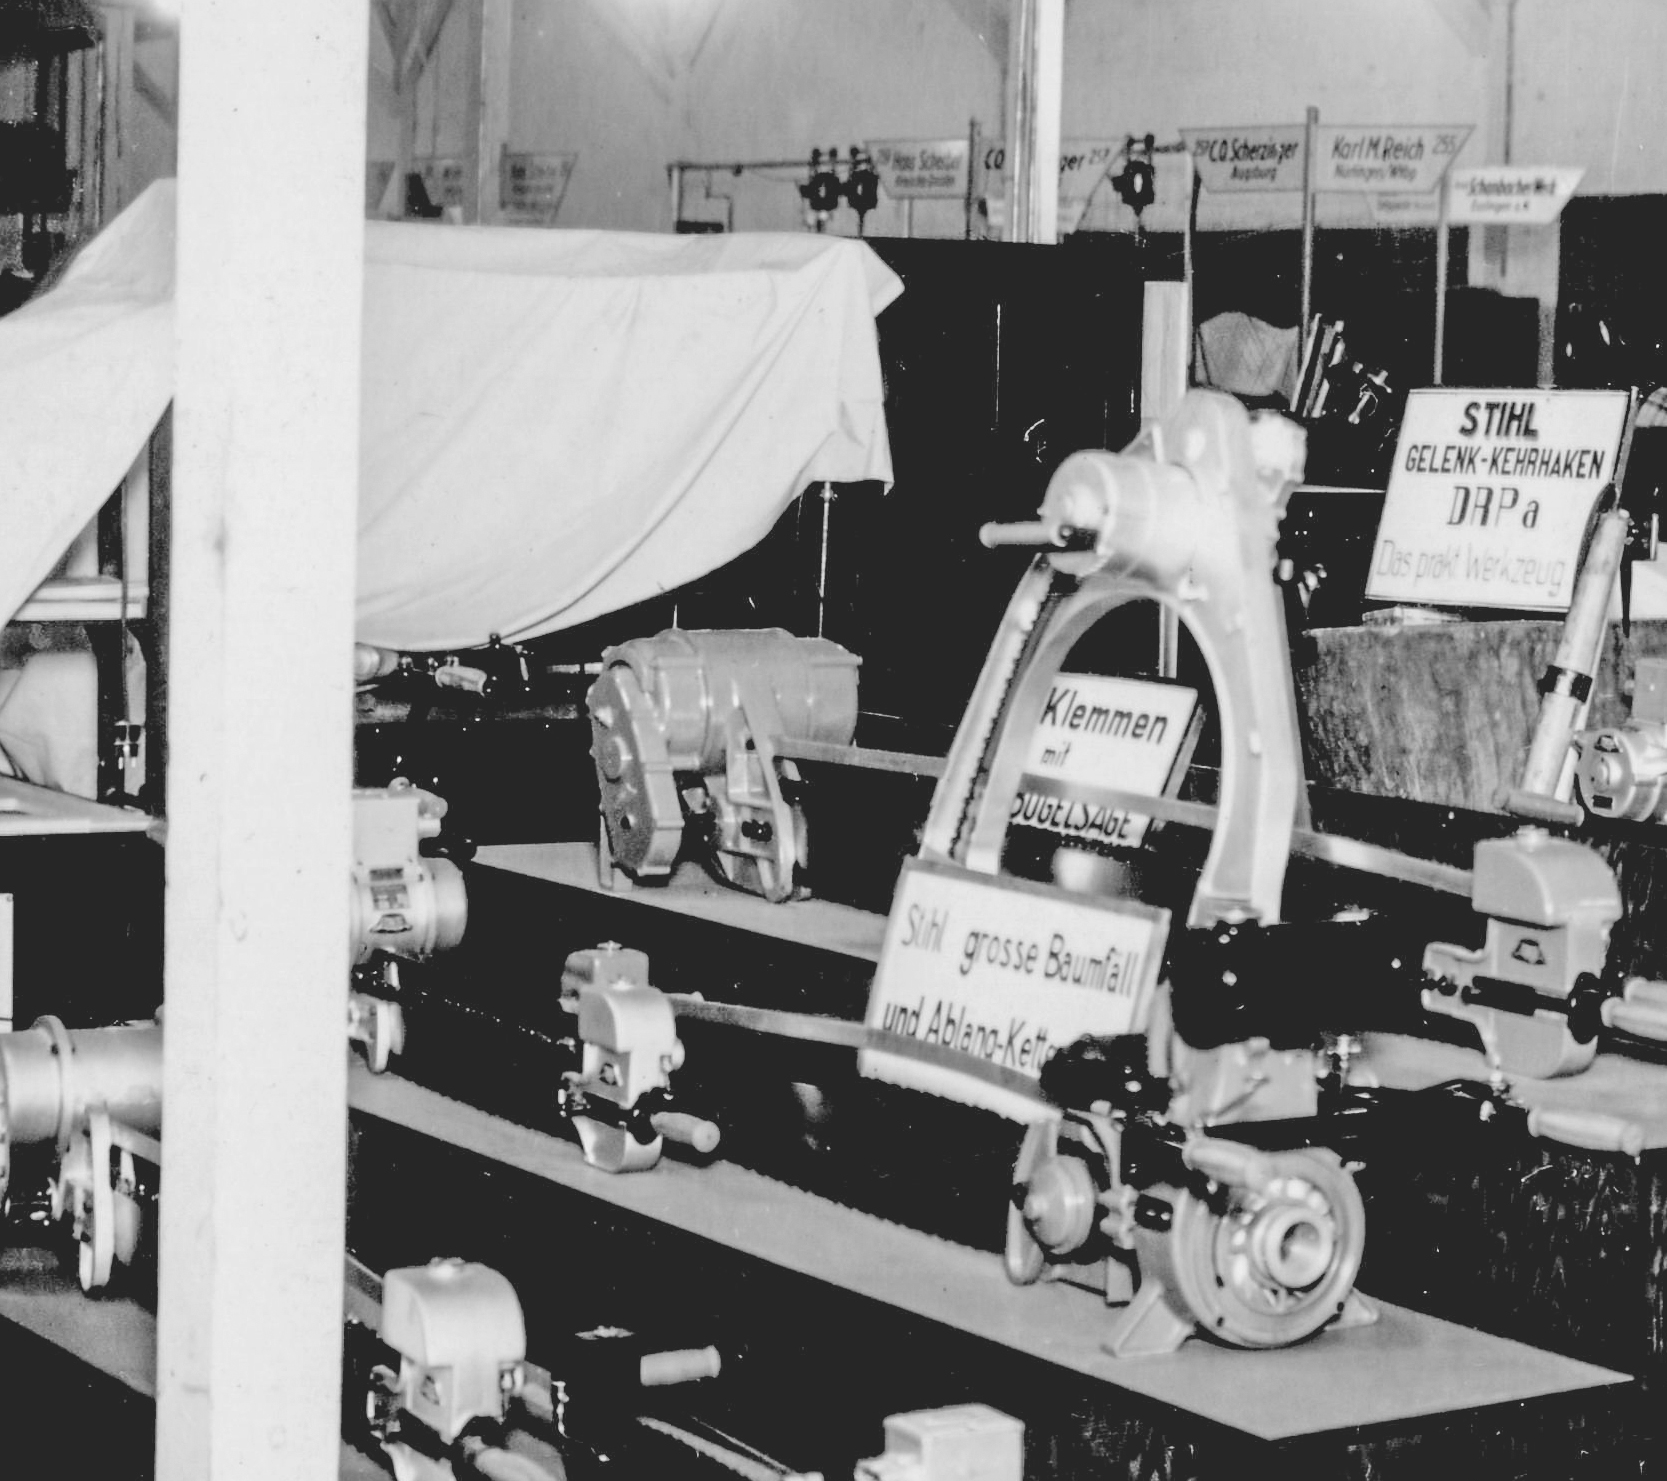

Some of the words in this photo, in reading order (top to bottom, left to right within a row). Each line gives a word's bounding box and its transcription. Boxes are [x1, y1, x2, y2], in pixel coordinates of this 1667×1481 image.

[1331, 135, 1366, 160] Karl
[1382, 135, 1424, 161] Reich
[1432, 134, 1459, 156] 255
[1458, 401, 1539, 439] STIHL
[1405, 444, 1606, 480] GELENK-KEHRHAKEN
[1376, 539, 1412, 577] Das
[1465, 543, 1565, 598] Werkzeug
[1040, 686, 1169, 745] Klemmen
[1040, 741, 1072, 767] mit
[901, 903, 949, 954] Stihl
[959, 929, 1039, 976] grosse
[1043, 933, 1139, 998] Baumfäll
[882, 996, 925, 1036] und
